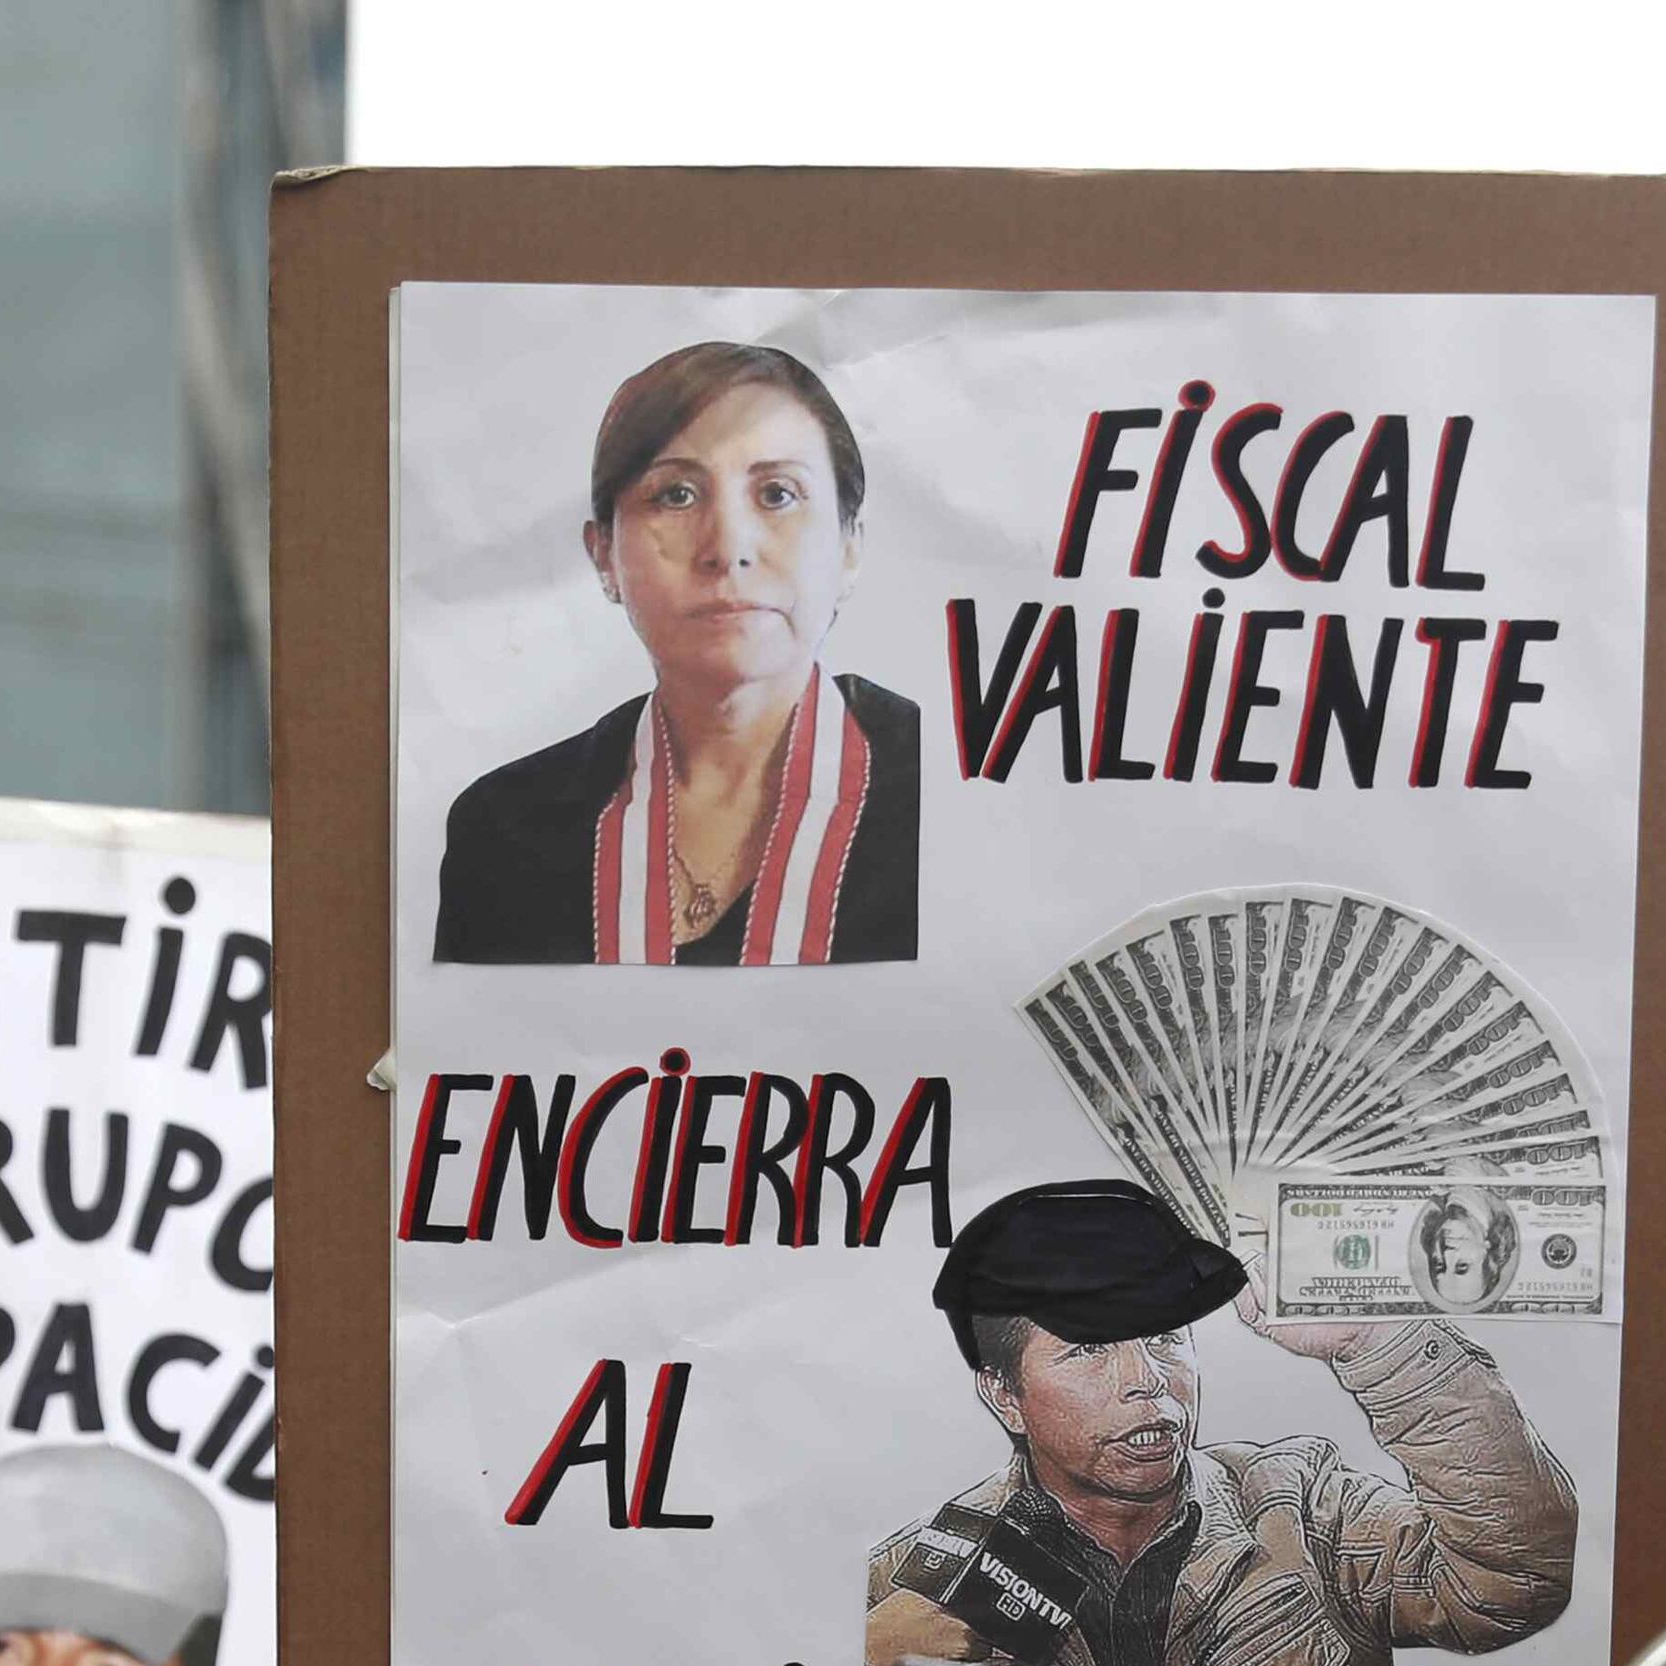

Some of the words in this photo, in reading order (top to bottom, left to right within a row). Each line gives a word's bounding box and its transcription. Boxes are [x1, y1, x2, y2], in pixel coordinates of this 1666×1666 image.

[1053, 378, 1486, 590] FISCAL
[947, 588, 1561, 789] VALIENTE
[398, 1048, 954, 1249] ENCIERRA
[505, 1358, 716, 1530] AL
